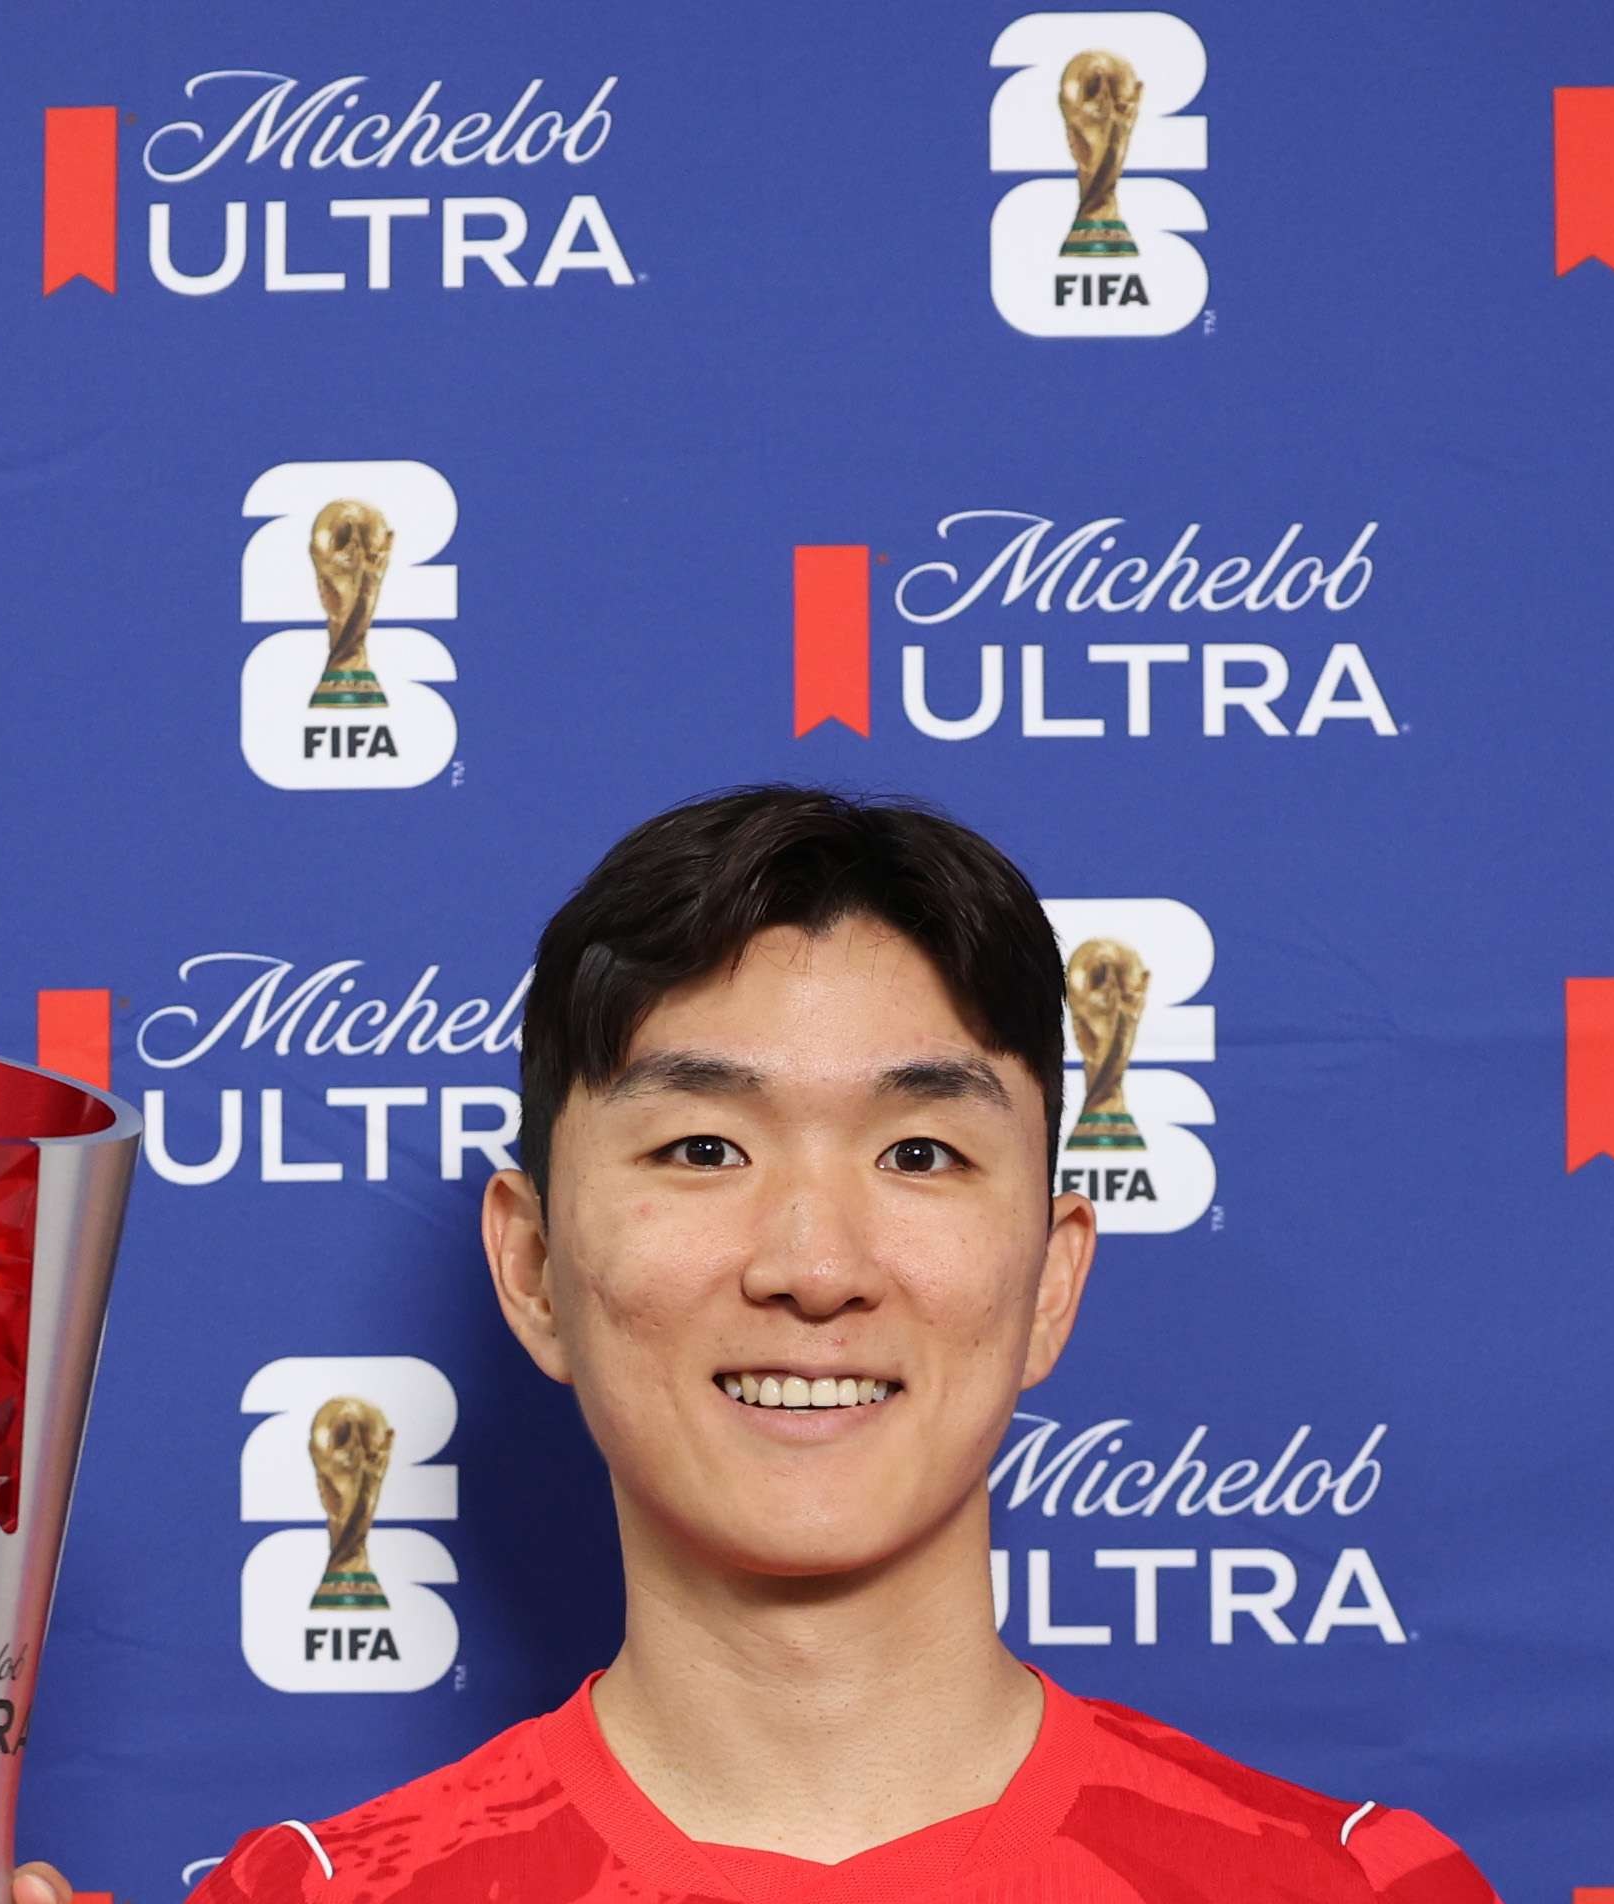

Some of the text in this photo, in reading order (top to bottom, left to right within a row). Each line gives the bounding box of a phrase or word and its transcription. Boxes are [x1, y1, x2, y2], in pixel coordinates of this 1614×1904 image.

[142, 70, 620, 185] Michelob
[148, 194, 637, 297] ULTRA
[1055, 274, 1149, 307] FIFA
[894, 509, 1380, 626] Michelob
[304, 725, 398, 759] FIFA
[902, 643, 1400, 742] ULTRA
[136, 952, 534, 1070] Michel
[143, 1085, 524, 1190] ULTR
[305, 1627, 400, 1662] FIFA
